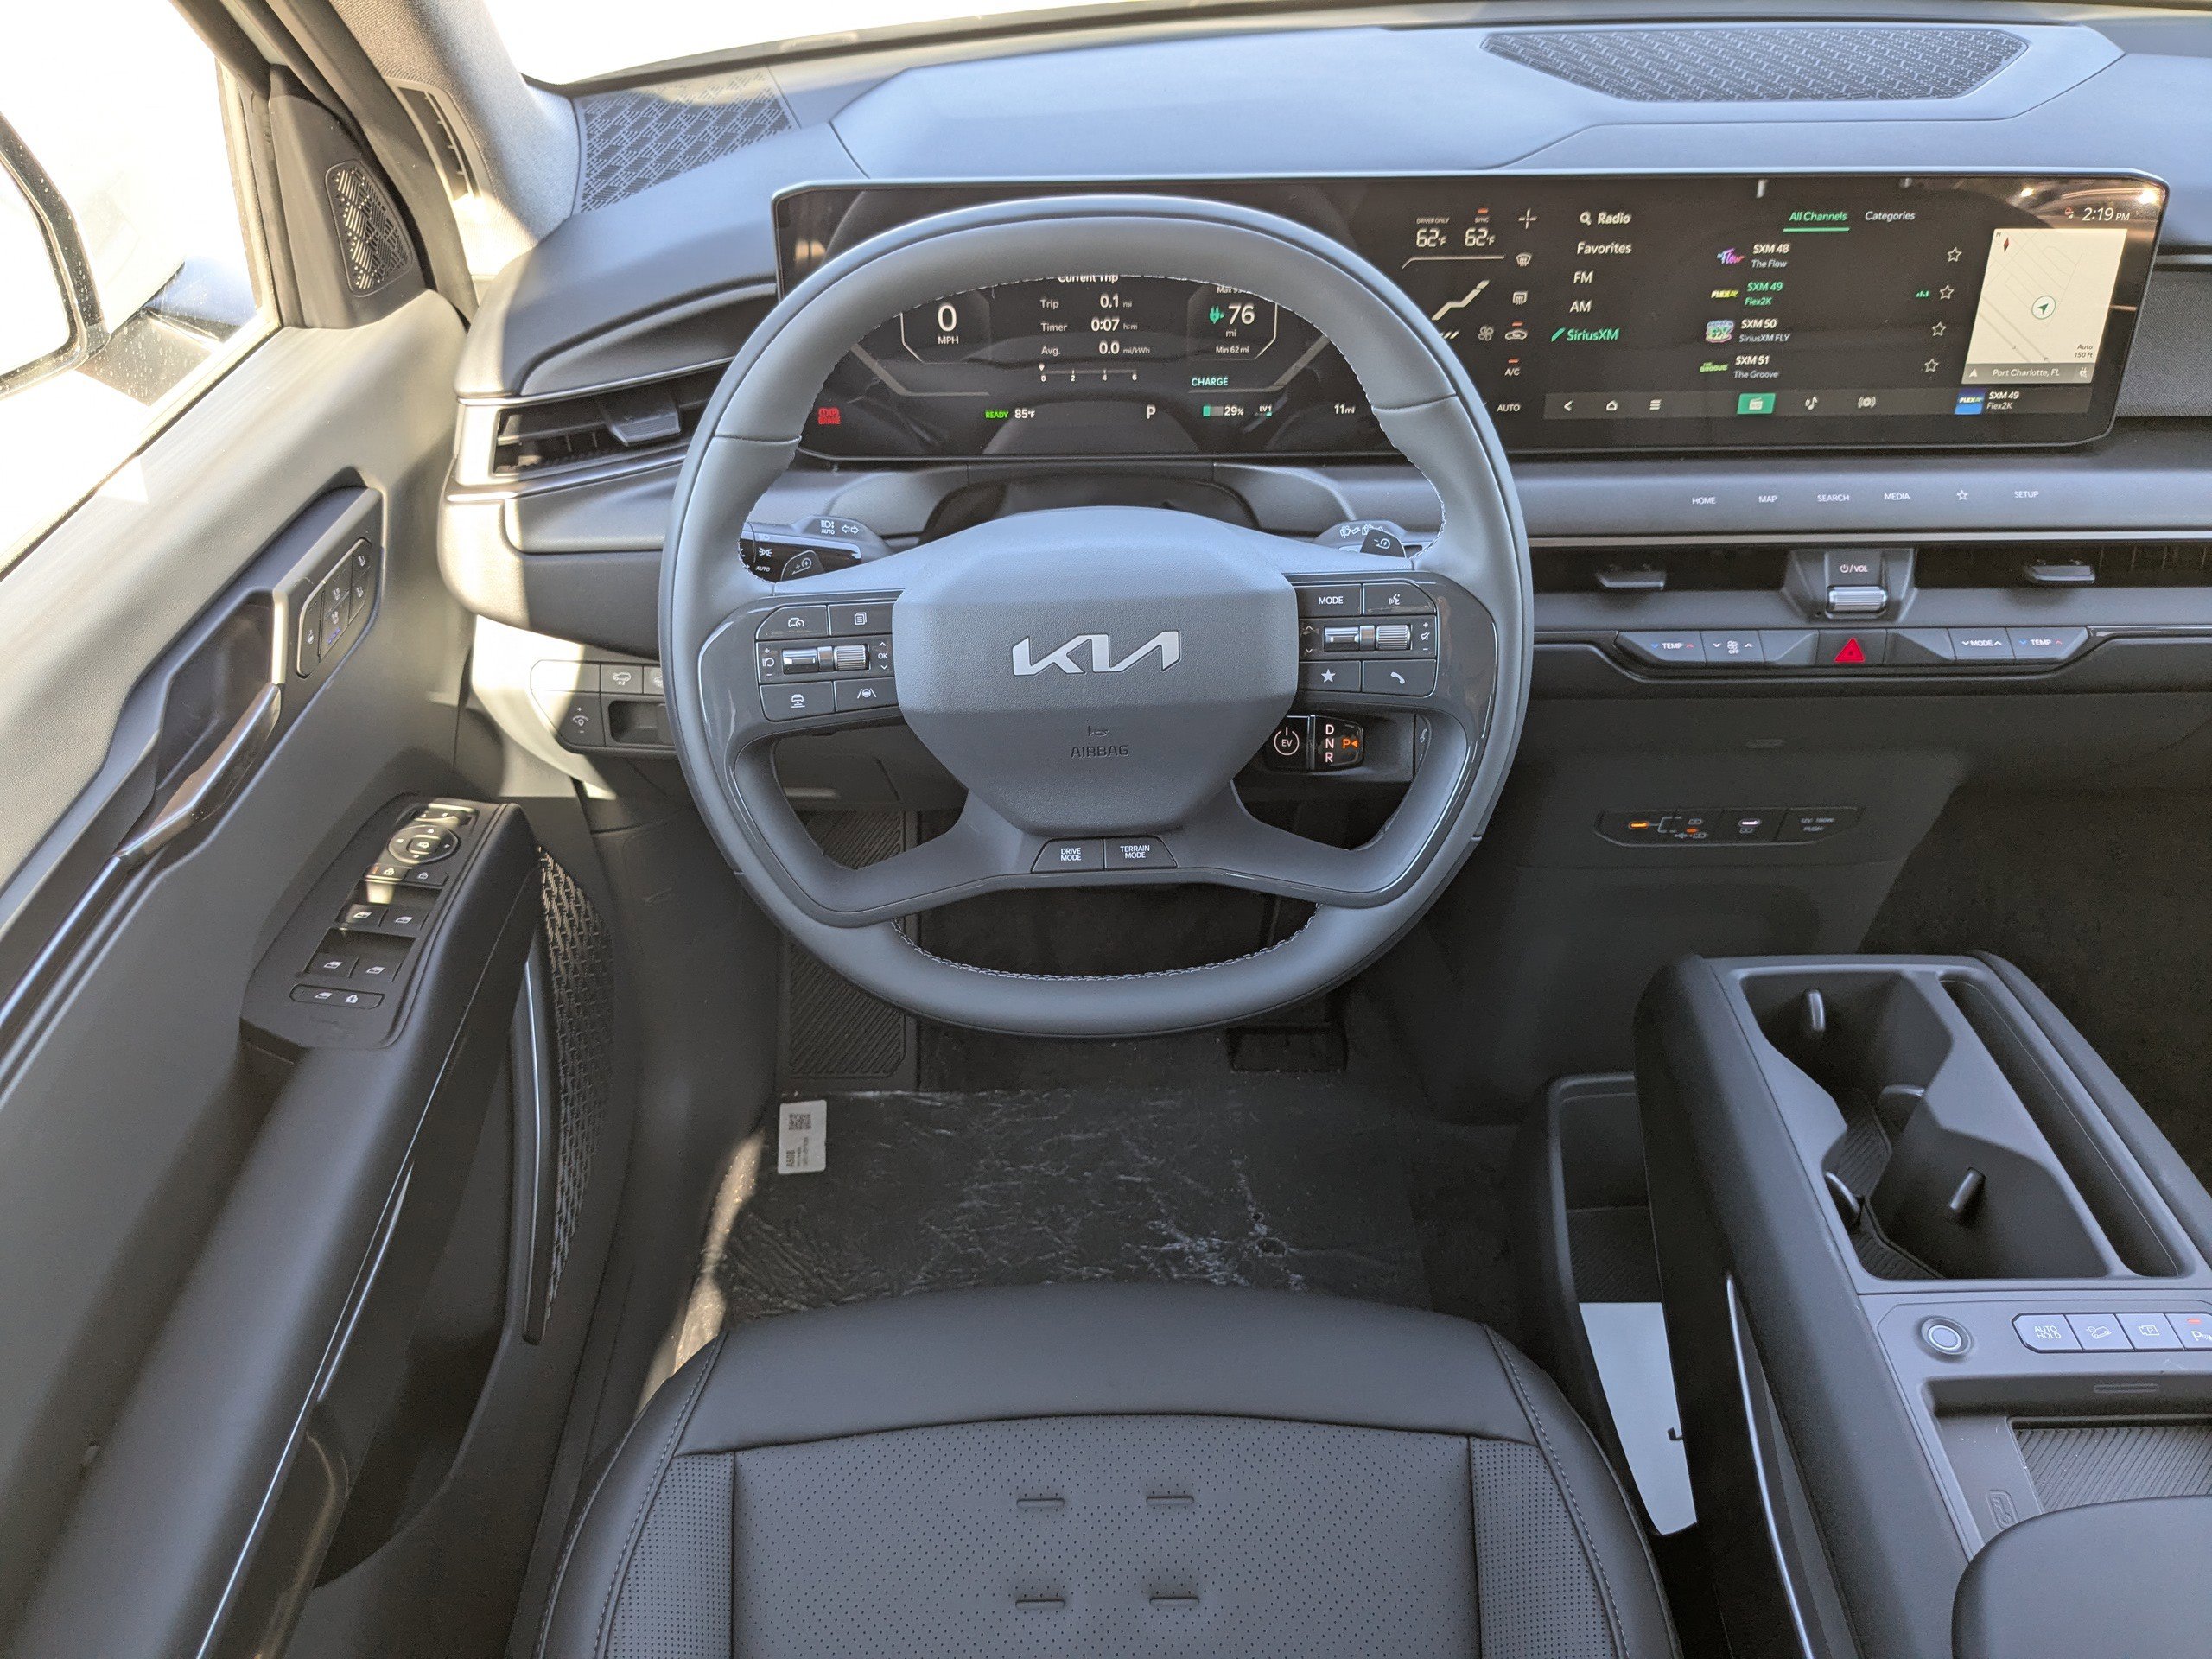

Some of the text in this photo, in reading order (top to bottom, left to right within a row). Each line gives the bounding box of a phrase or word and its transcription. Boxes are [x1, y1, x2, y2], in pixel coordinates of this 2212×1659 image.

[1598, 211, 1632, 225] Radio
[1789, 211, 1847, 222] All Channels
[1865, 211, 1916, 223] Categories
[2082, 207, 2113, 221] 2:19
[1577, 241, 1632, 255] Favorites
[1753, 244, 1789, 254] SXM 48
[1751, 259, 1788, 268] The Flow
[1573, 270, 1594, 283] FM
[1747, 282, 1783, 292] SXM 49
[1040, 299, 1059, 310] Trip
[1100, 294, 1119, 308] 0.1
[1570, 300, 1592, 312] AM
[1745, 296, 1772, 306] Flex2K
[938, 303, 957, 332] 0
[1228, 304, 1255, 325] 76
[1040, 322, 1068, 332] Timer
[1090, 317, 1121, 332] 0:07
[1741, 319, 1778, 329] SXM 50
[1567, 328, 1620, 341] SiriusXM
[1739, 334, 1791, 343] SiriusXM FLY
[938, 336, 959, 345] MPH
[1041, 346, 1061, 357] Avg.
[1098, 340, 1121, 354] 0.0
[1735, 355, 1770, 365] SXM 51
[1504, 367, 1521, 377] A/C
[1750, 370, 1779, 378] Groove
[2011, 369, 2049, 378] Charlotte,
[2050, 368, 2060, 377] FL
[1191, 378, 1229, 386] CHARGE
[1989, 391, 2020, 400] SXM 49
[1146, 405, 1156, 419] P
[1224, 405, 1244, 416] 29%
[1497, 404, 1521, 413] AUTO
[985, 410, 1009, 419] READY
[1817, 493, 1850, 502] SEARCH
[2014, 490, 2039, 499] SETUP
[1692, 496, 1717, 505] HOME
[1318, 595, 1344, 605] MODE
[1012, 630, 1180, 677] KIA
[1325, 725, 1334, 734] D
[1281, 739, 1293, 747] EV
[1325, 739, 1334, 749] N
[1342, 739, 1351, 749] P
[1070, 745, 1129, 759] AIRBAG
[1325, 753, 1333, 763] R
[1120, 844, 1150, 854] TERRAIN
[2037, 1332, 2062, 1340] HOLD
